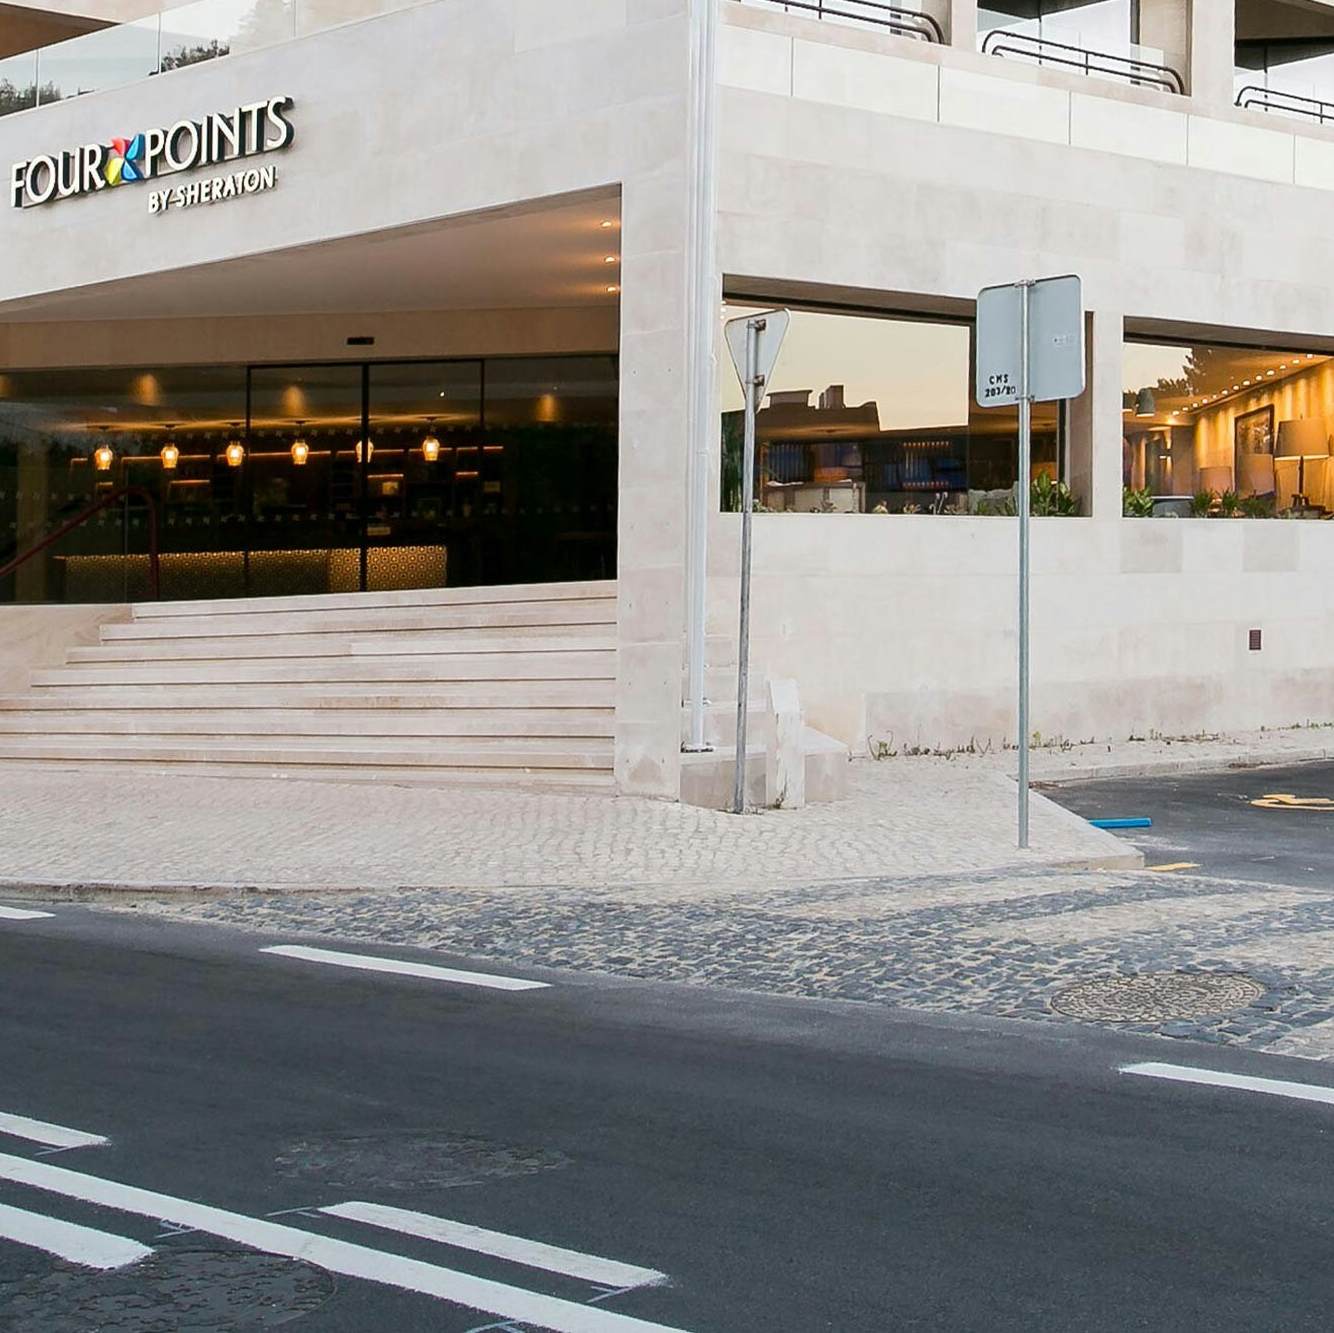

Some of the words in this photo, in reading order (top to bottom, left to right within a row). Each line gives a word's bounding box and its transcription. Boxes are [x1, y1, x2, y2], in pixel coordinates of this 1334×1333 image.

[10, 143, 107, 208] FOUR
[145, 95, 294, 177] POINTS
[148, 189, 175, 214] BY
[176, 166, 278, 207] SHERATON
[989, 373, 1009, 385] CMS
